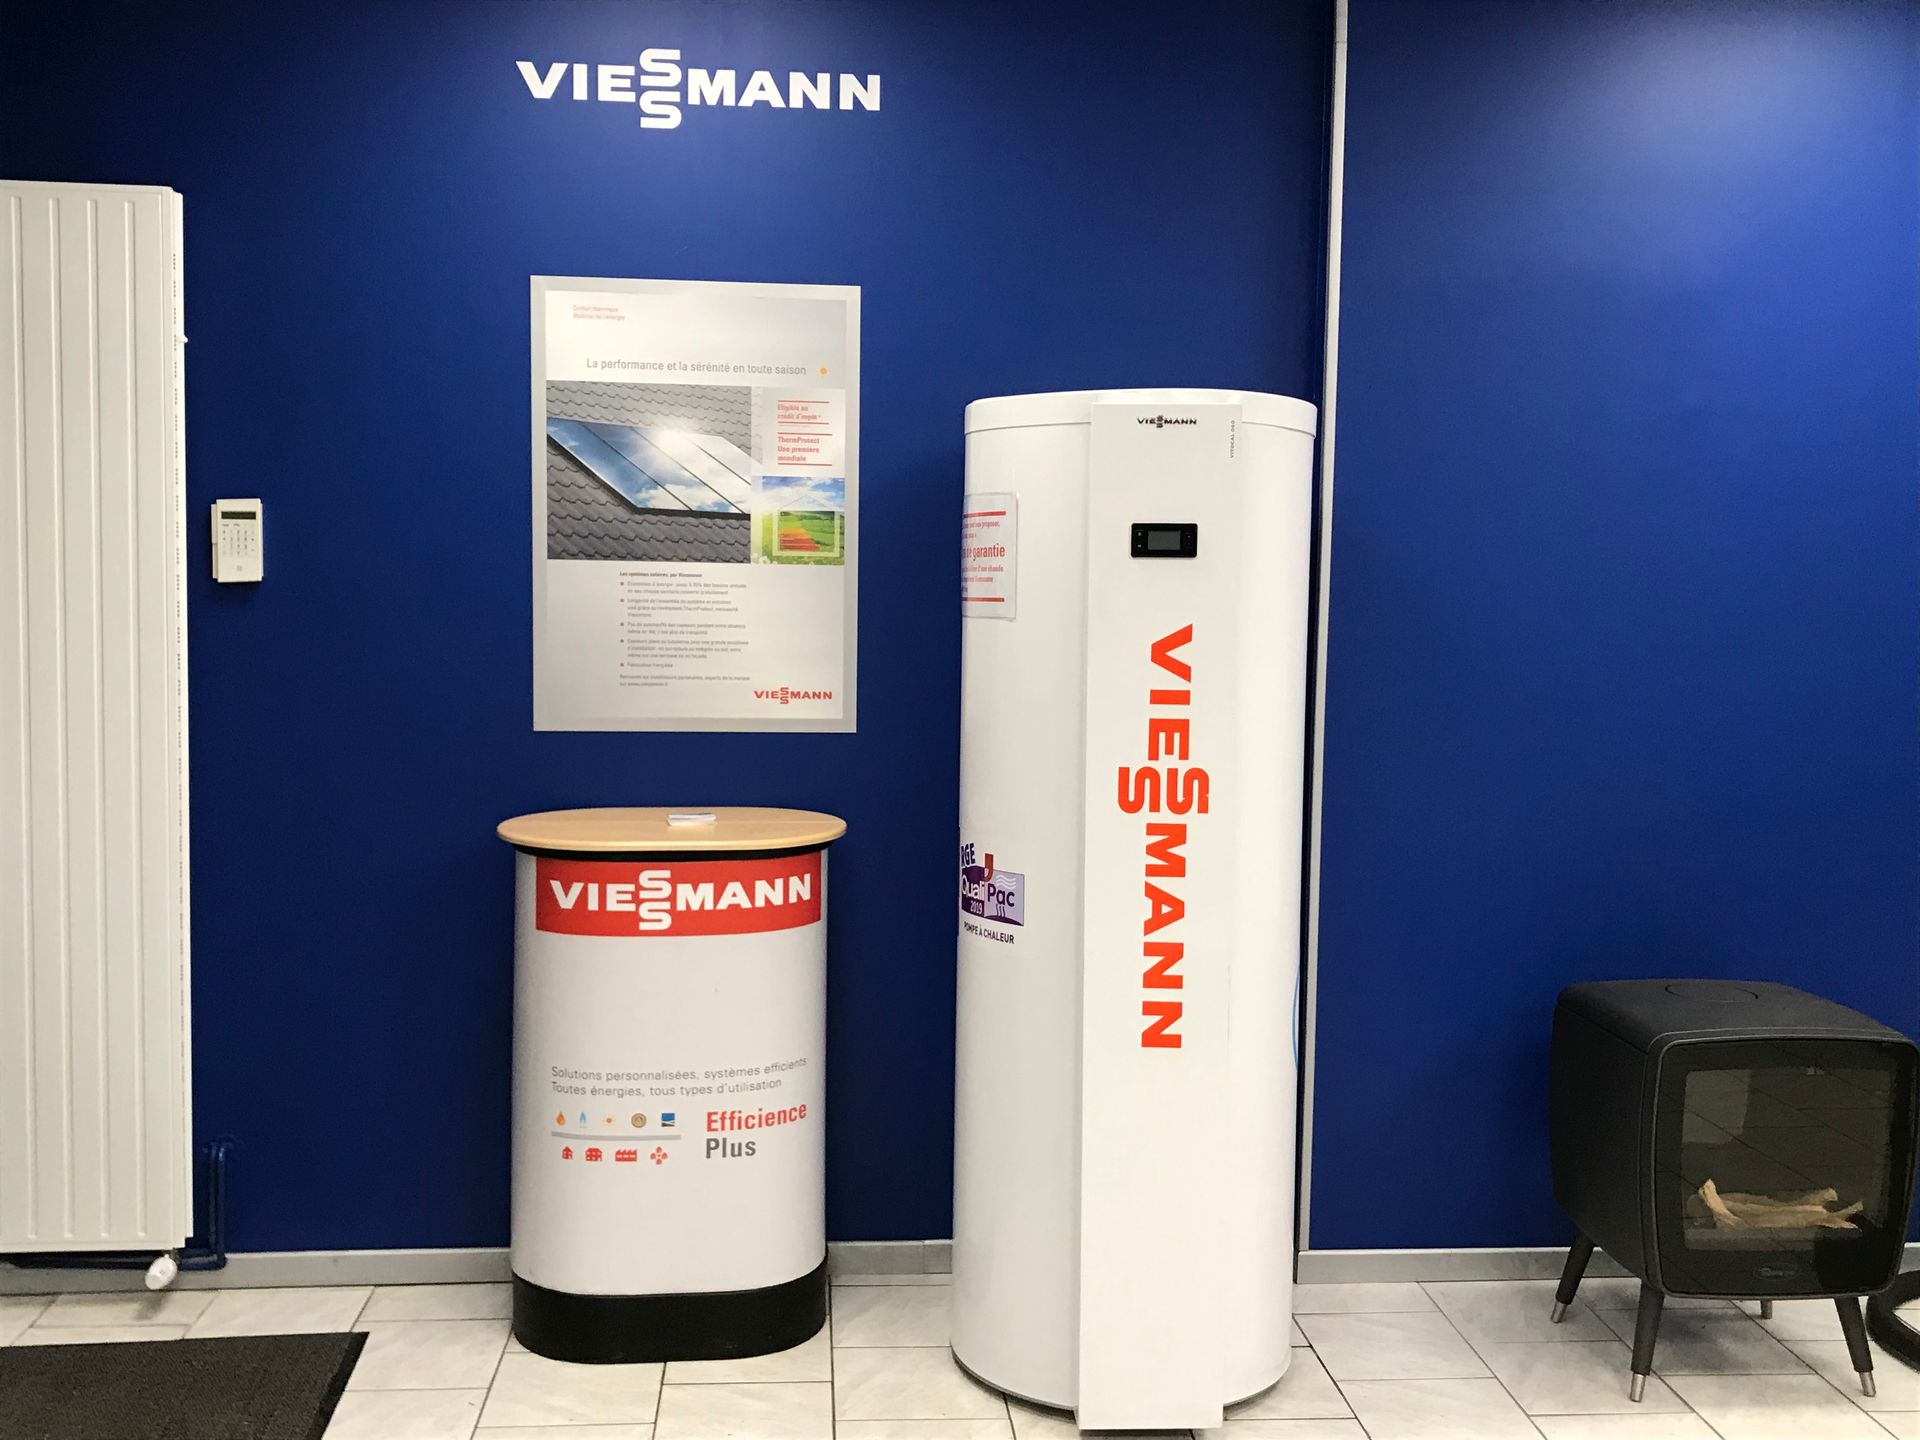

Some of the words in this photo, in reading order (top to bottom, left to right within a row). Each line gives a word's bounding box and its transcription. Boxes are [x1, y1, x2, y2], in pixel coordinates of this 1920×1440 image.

[516, 48, 880, 129] VIESSMANN
[586, 357, 598, 369] La
[601, 358, 664, 372] performance
[667, 361, 677, 371] et
[679, 360, 688, 372] la
[690, 361, 730, 373] sérénité
[733, 365, 745, 373] en
[748, 362, 773, 375] toute
[775, 364, 807, 375] saison
[1137, 414, 1197, 429] VIESSMANN
[777, 436, 820, 444] ThermProtect
[973, 543, 1006, 562] garantie
[753, 687, 832, 704] VIESSMANN
[1118, 623, 1210, 1049] VIESSMANN
[550, 870, 811, 930] VIESSMANN
[983, 928, 1015, 945] CHALEUR
[551, 1066, 602, 1080] Solutions
[605, 1069, 699, 1082] personnalisées,
[704, 1066, 760, 1080] systèmes
[764, 1057, 807, 1074] efficients
[552, 1081, 586, 1096] Toutes
[590, 1086, 645, 1098] énergies,
[649, 1086, 676, 1096] tous
[680, 1085, 713, 1097] types
[717, 1079, 782, 1094] d'utilisation
[706, 1103, 808, 1133] Efficience
[705, 1138, 757, 1159] Plus
